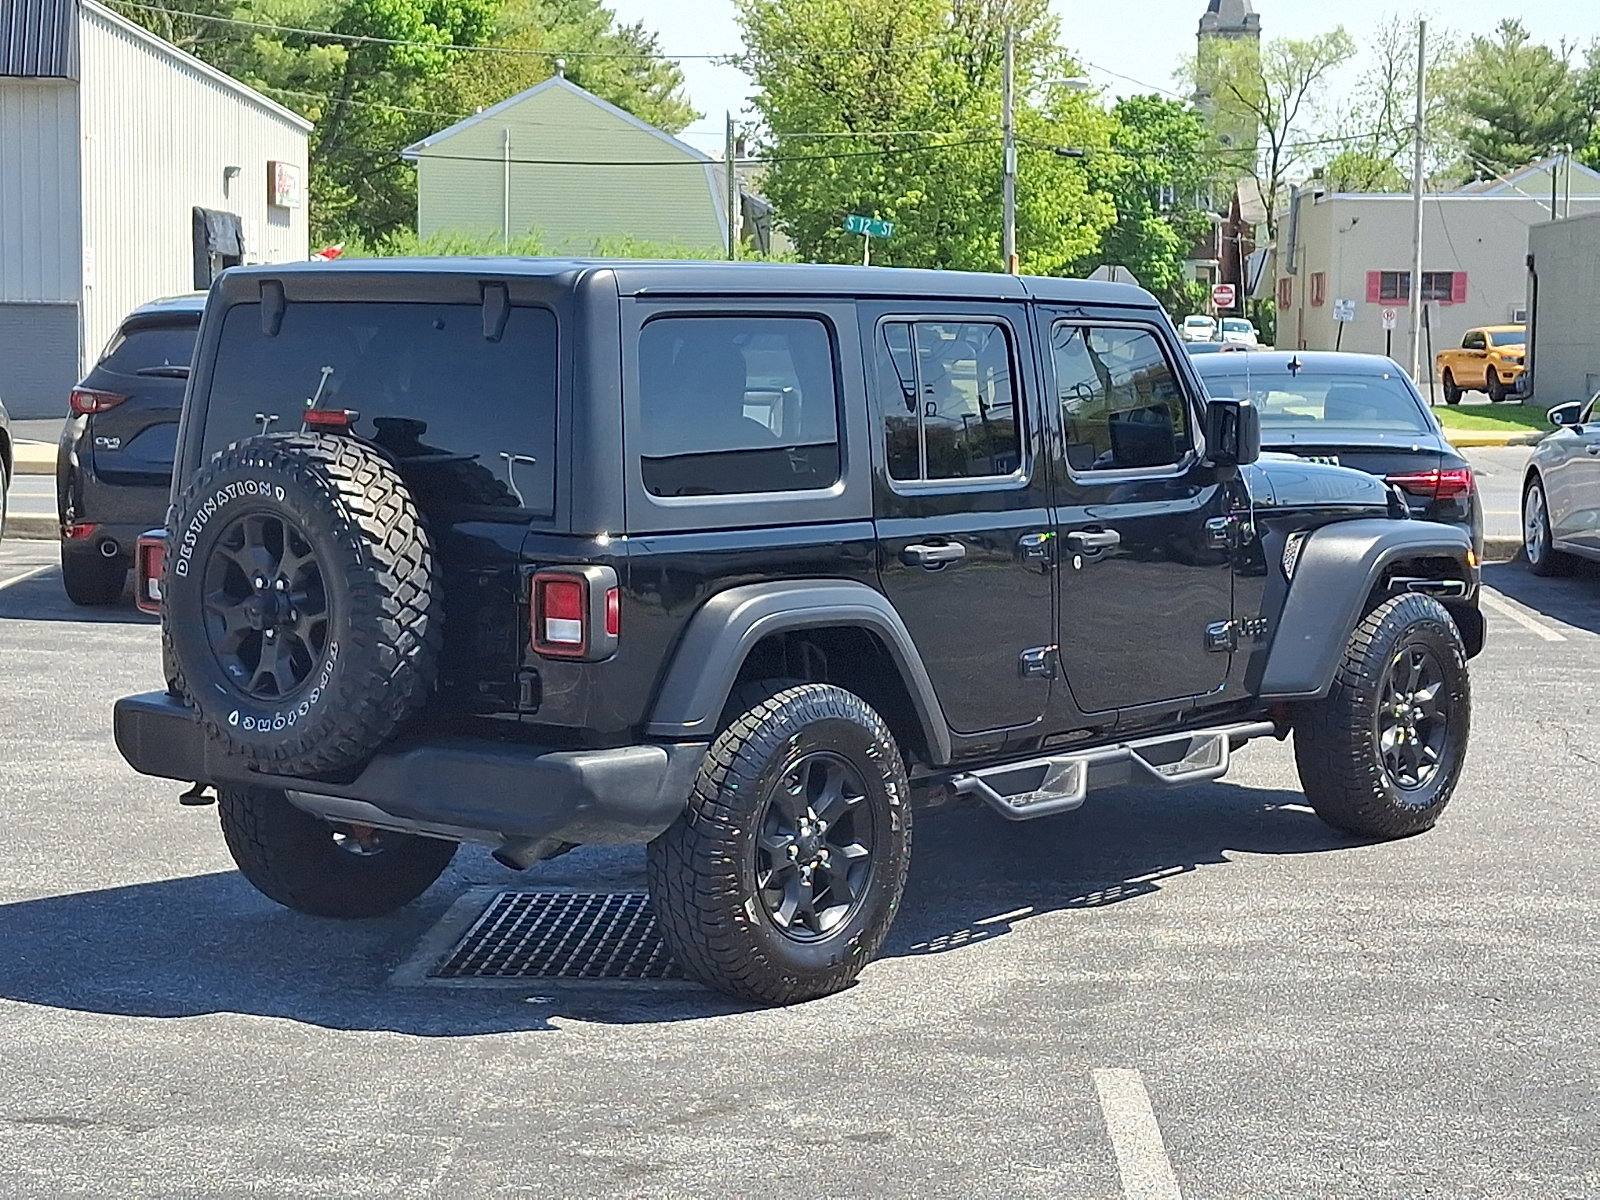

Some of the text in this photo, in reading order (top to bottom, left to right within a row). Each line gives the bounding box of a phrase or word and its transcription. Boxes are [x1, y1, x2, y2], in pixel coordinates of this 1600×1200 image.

[847, 216, 894, 237] S 12 ST
[175, 479, 273, 577] DESTINATION
